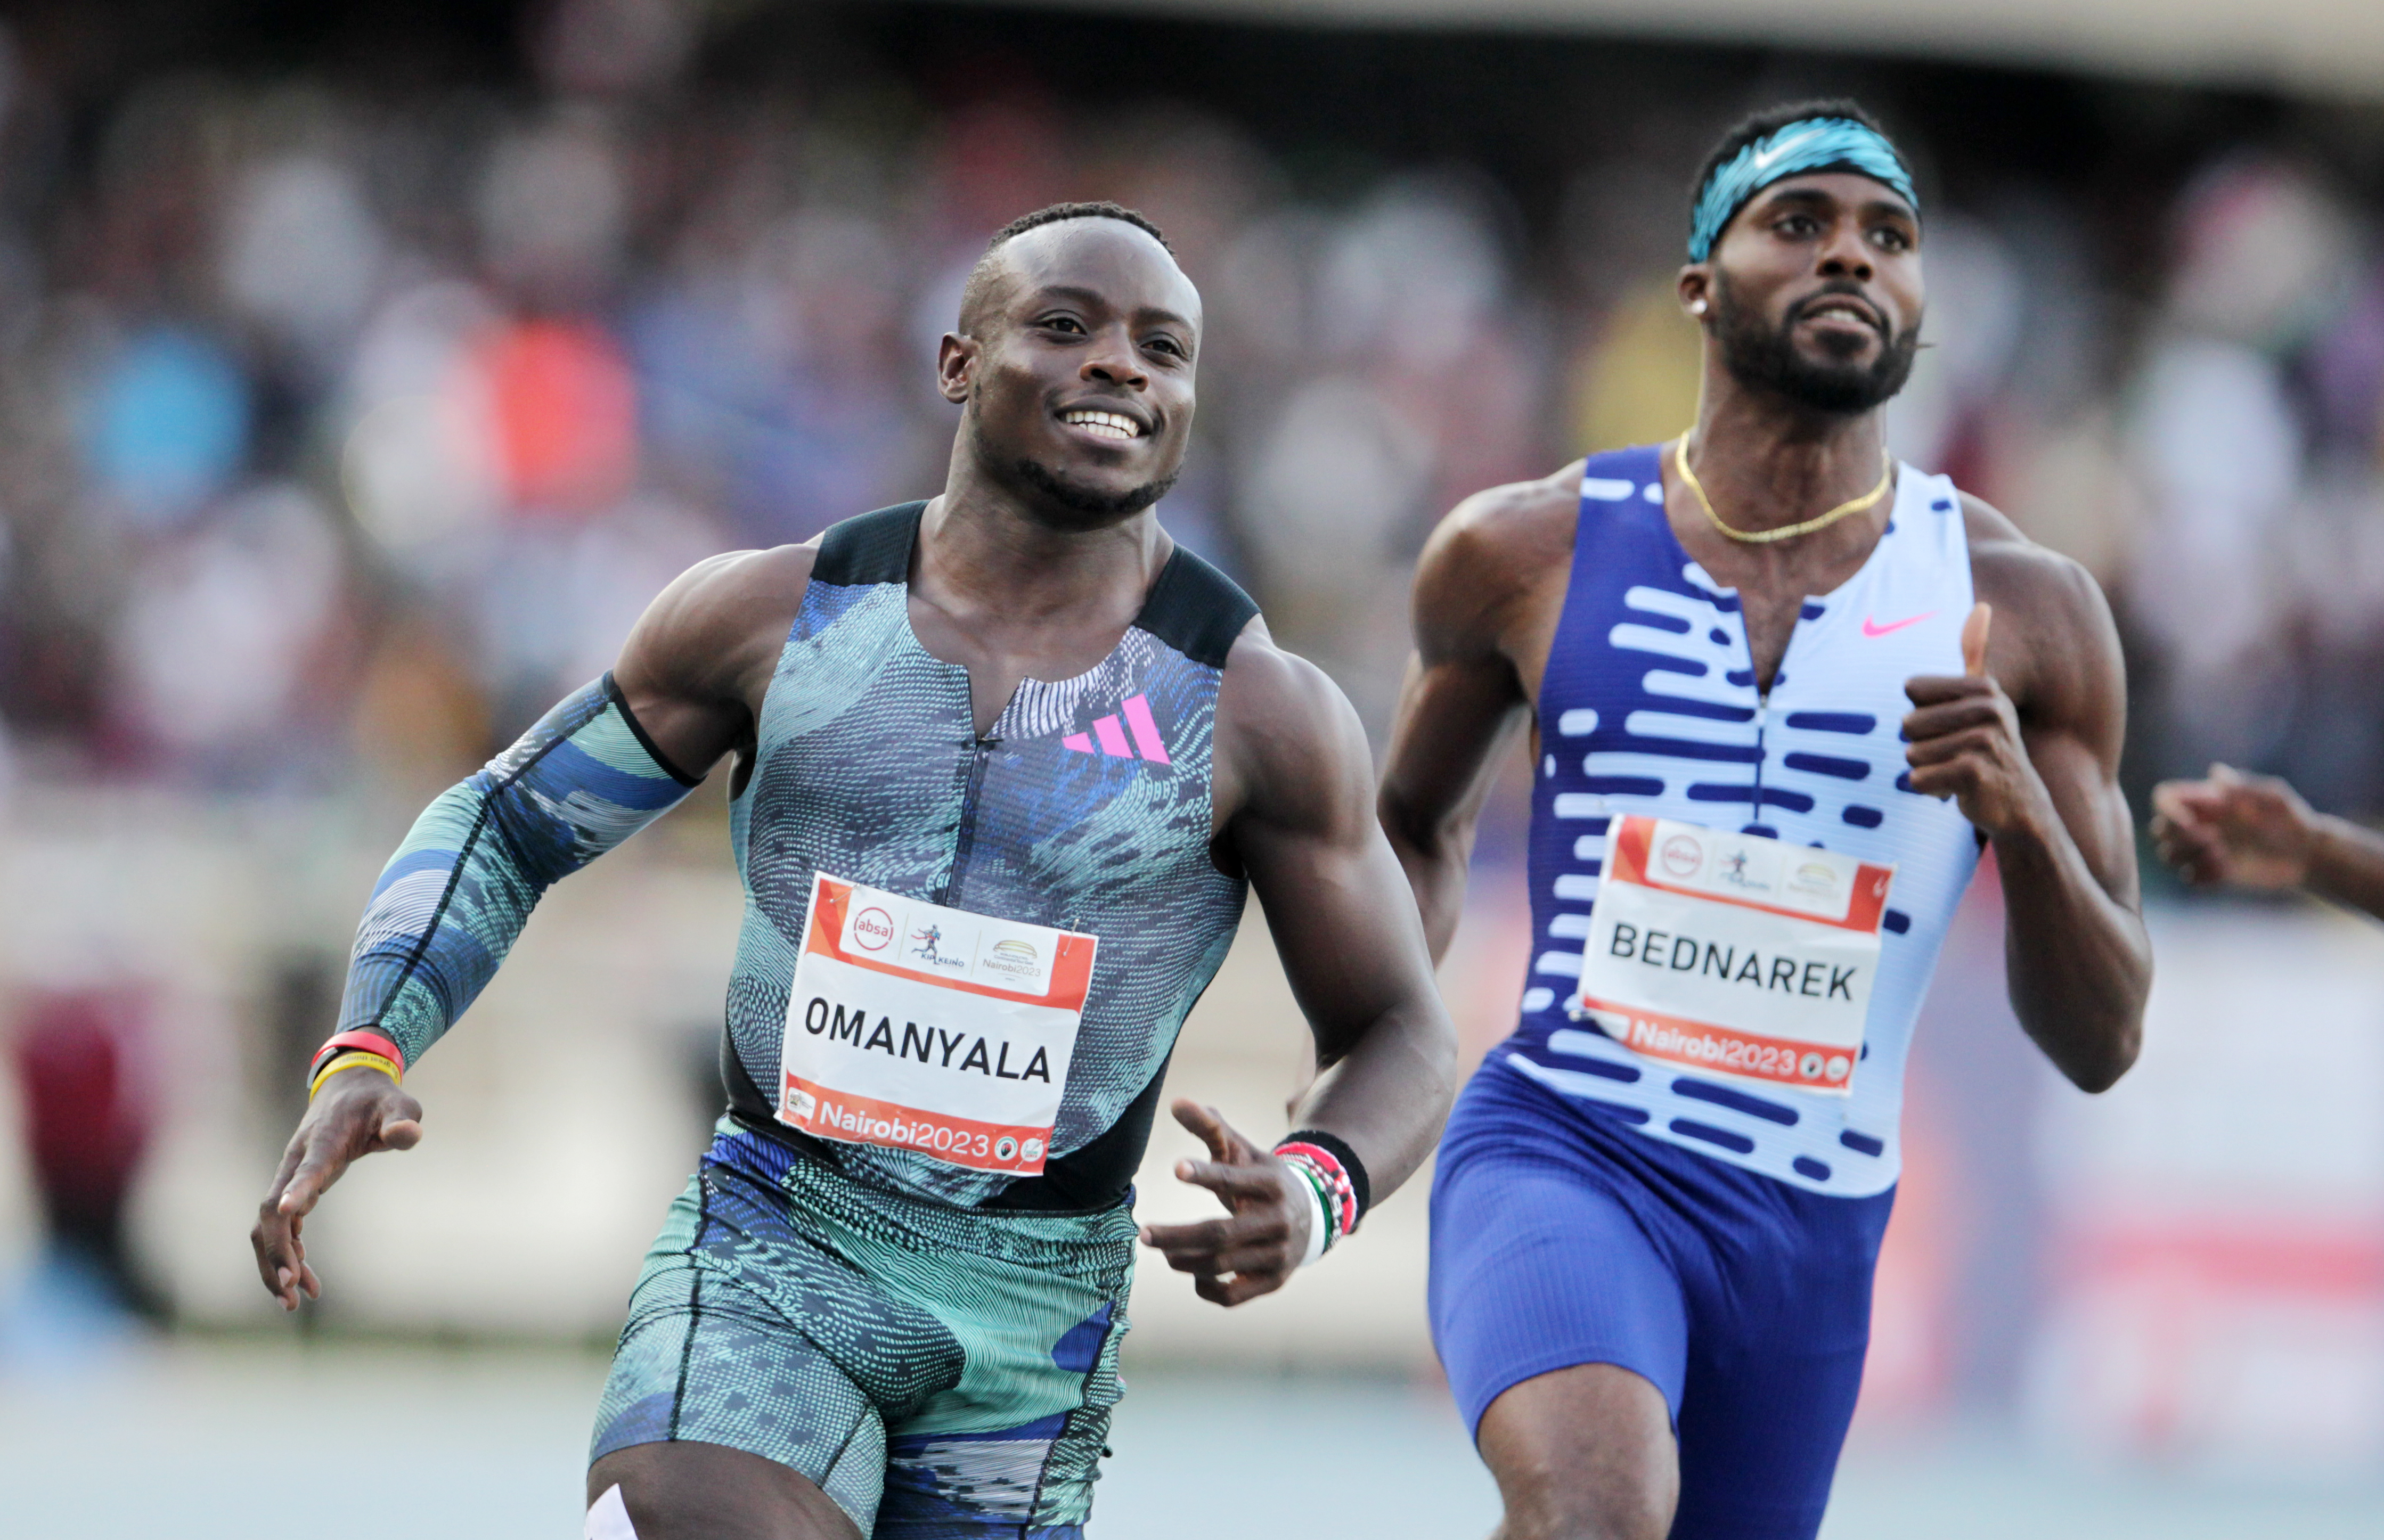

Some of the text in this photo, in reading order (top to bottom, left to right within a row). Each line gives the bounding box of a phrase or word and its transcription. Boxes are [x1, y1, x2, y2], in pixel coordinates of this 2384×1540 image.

[858, 919, 888, 937] absa
[938, 957, 964, 967] KEINO
[983, 959, 1041, 977] Nairobi2023
[1610, 923, 1858, 1000] BEDNAREK
[805, 997, 1051, 1084] OMANYALA
[1632, 1019, 1797, 1076] Nairobi2023
[819, 1102, 989, 1158] Nairobi2023
